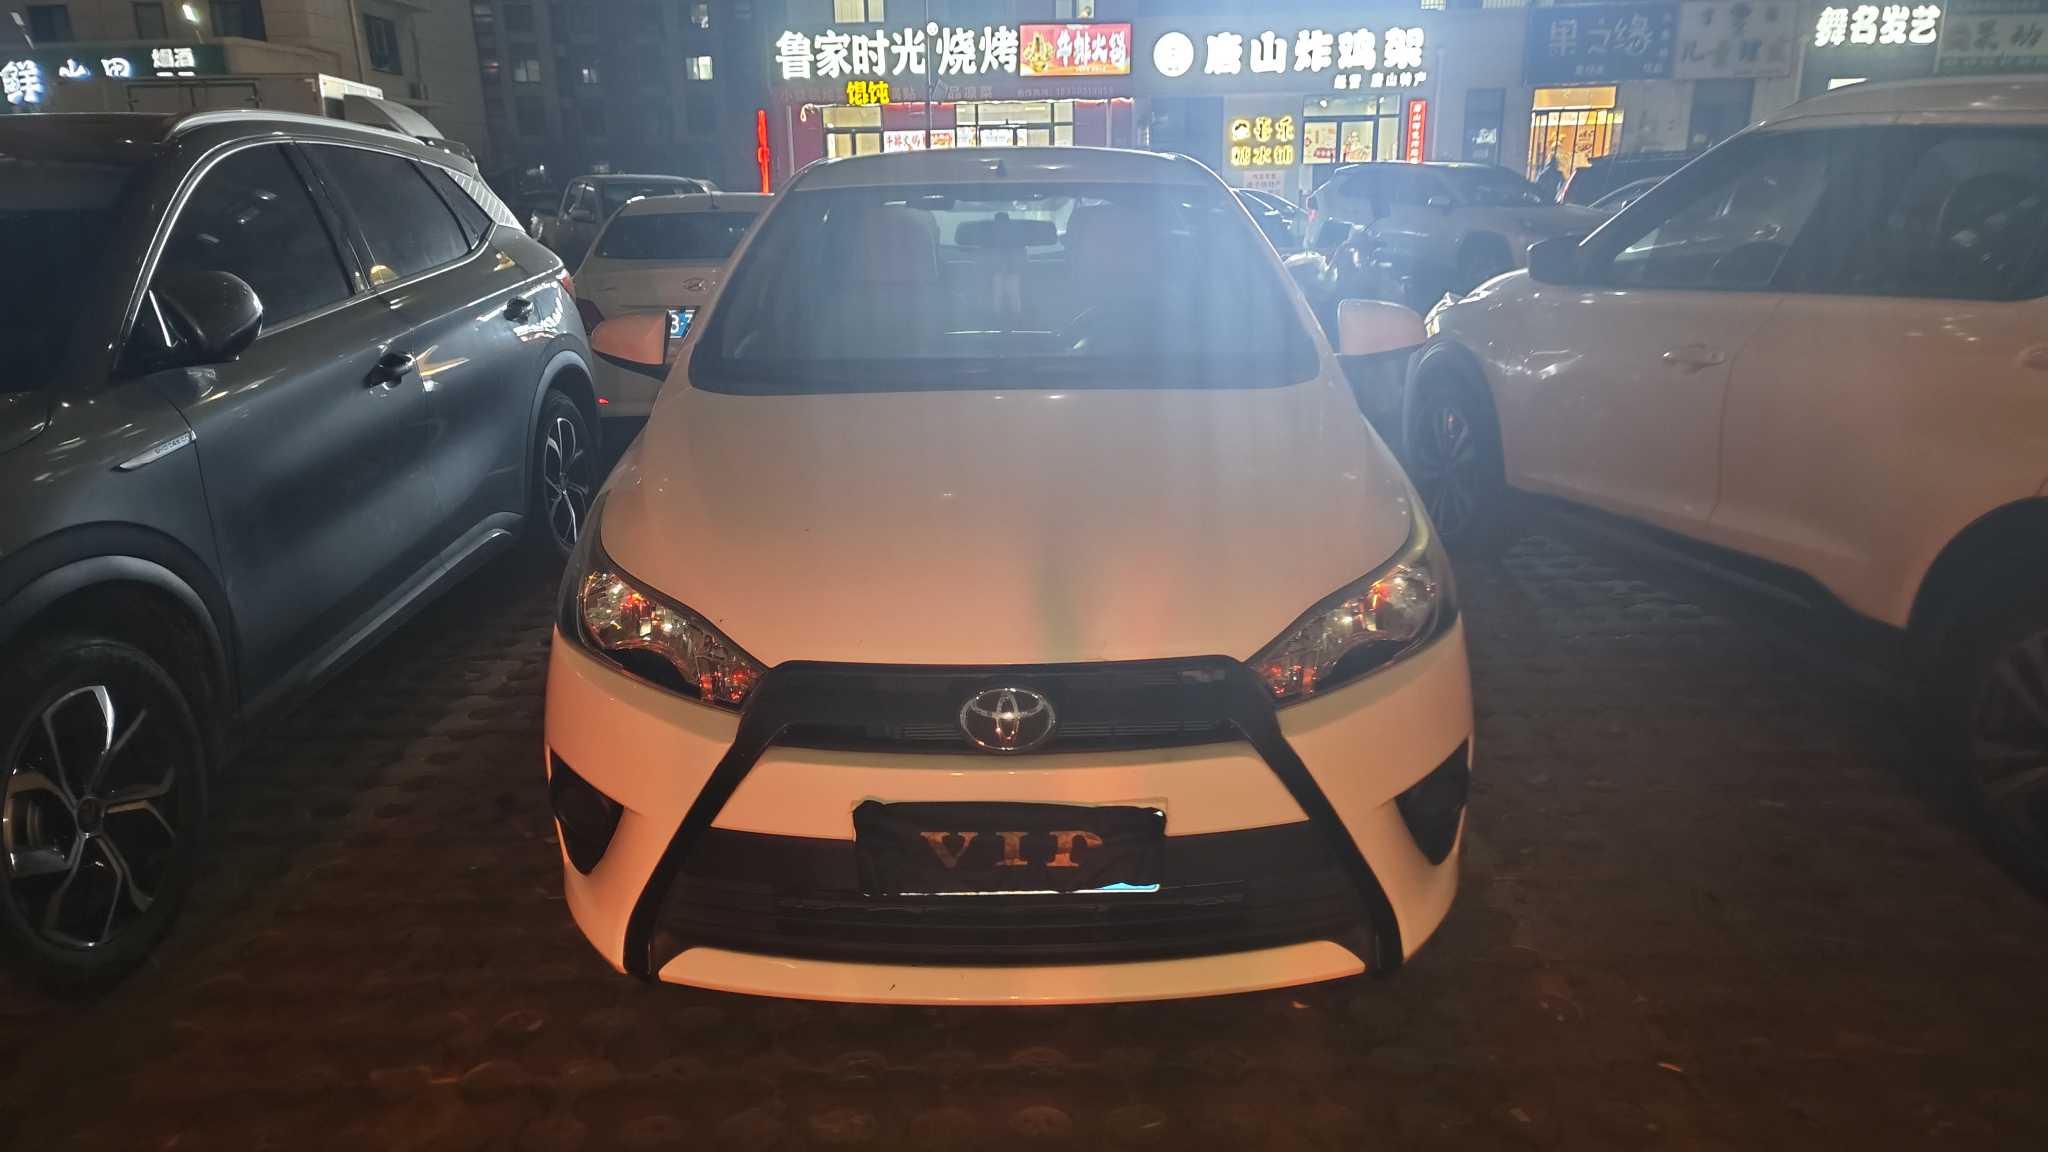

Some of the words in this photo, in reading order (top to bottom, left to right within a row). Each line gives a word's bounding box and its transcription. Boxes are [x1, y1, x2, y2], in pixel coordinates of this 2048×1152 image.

[151, 47, 196, 68] 烟酒
[1204, 27, 1424, 75] 唐山炸鸡架
[846, 81, 890, 105] 馄饨
